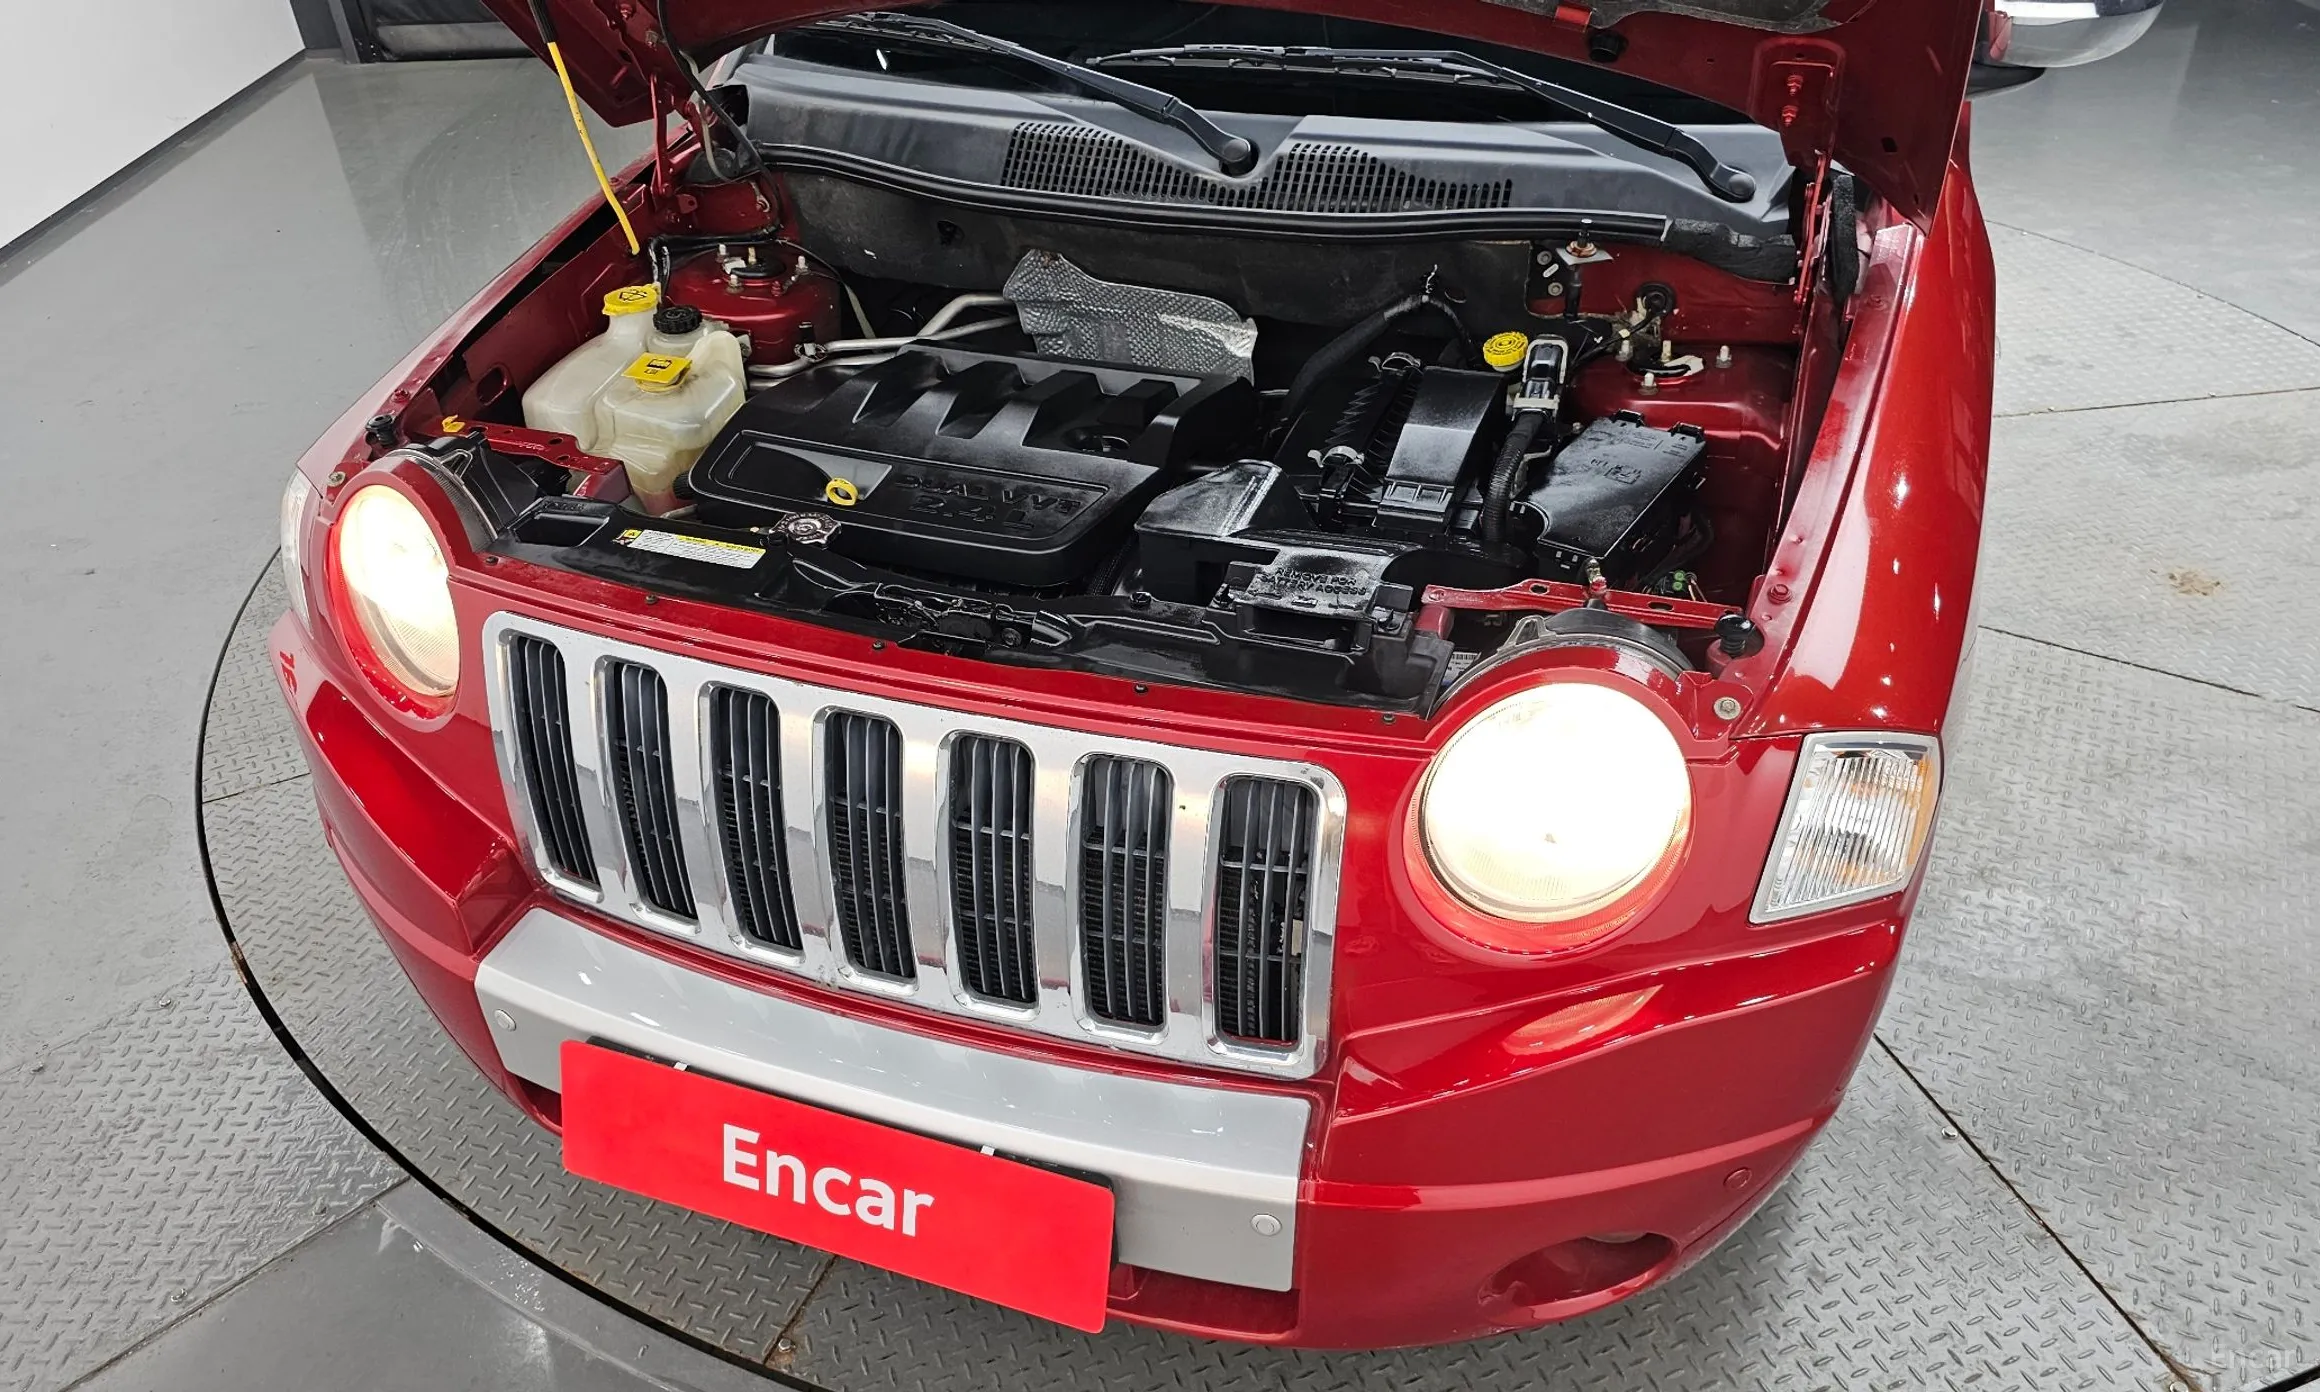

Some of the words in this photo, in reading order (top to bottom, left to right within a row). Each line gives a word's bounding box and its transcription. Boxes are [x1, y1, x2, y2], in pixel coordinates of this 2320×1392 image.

[895, 475, 990, 501] DUAL
[1001, 487, 1081, 514] VVT
[722, 1123, 935, 1237] Encar
